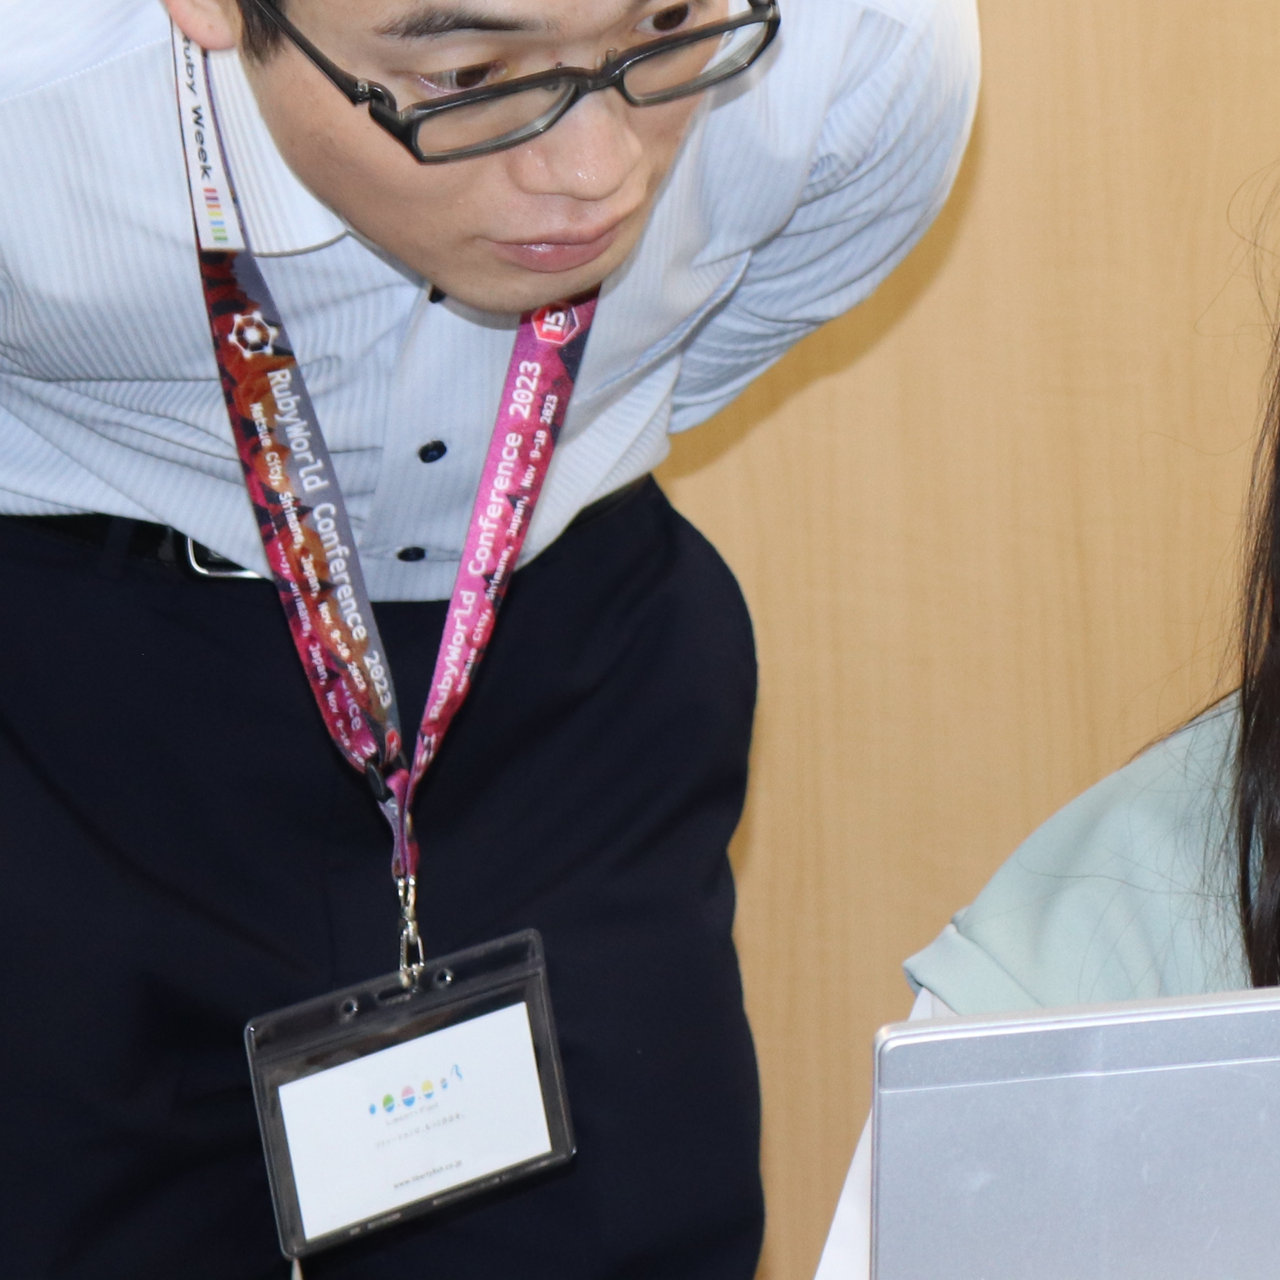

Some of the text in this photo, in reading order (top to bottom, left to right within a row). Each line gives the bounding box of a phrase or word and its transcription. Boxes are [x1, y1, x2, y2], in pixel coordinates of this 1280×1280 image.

[192, 105, 212, 180] Week
[507, 495, 530, 537] Japan,
[521, 464, 537, 488] Nov
[267, 369, 392, 708] RubyWorld Conference 2023
[429, 360, 541, 719] RubyWorld Conference 2023
[301, 554, 320, 597] Japan,
[318, 602, 333, 625] Nov
